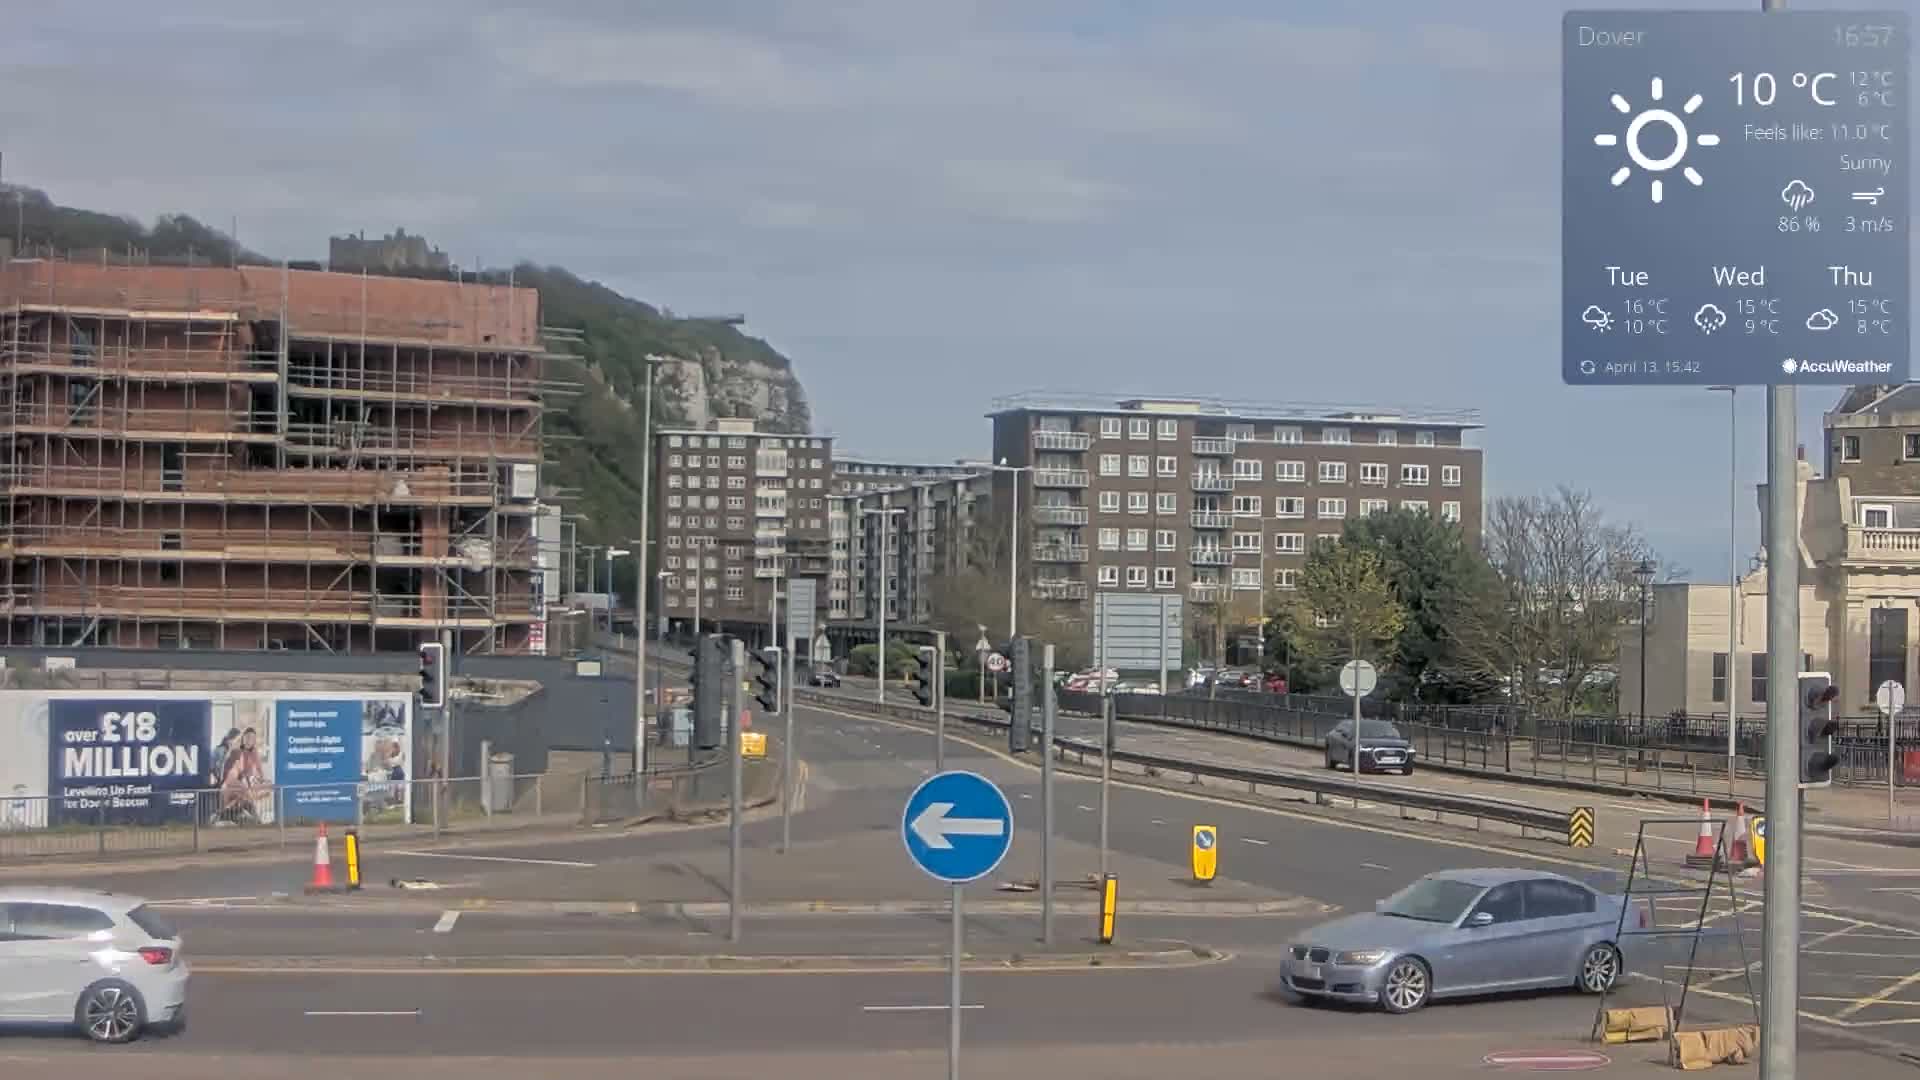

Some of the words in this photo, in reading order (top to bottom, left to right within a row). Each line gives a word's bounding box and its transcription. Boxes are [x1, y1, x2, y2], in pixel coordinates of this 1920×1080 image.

[64, 729, 98, 742] over
[101, 711, 156, 742] £18
[64, 744, 199, 777] MILLION
[110, 784, 126, 797] Up
[80, 798, 110, 809] Dovr
